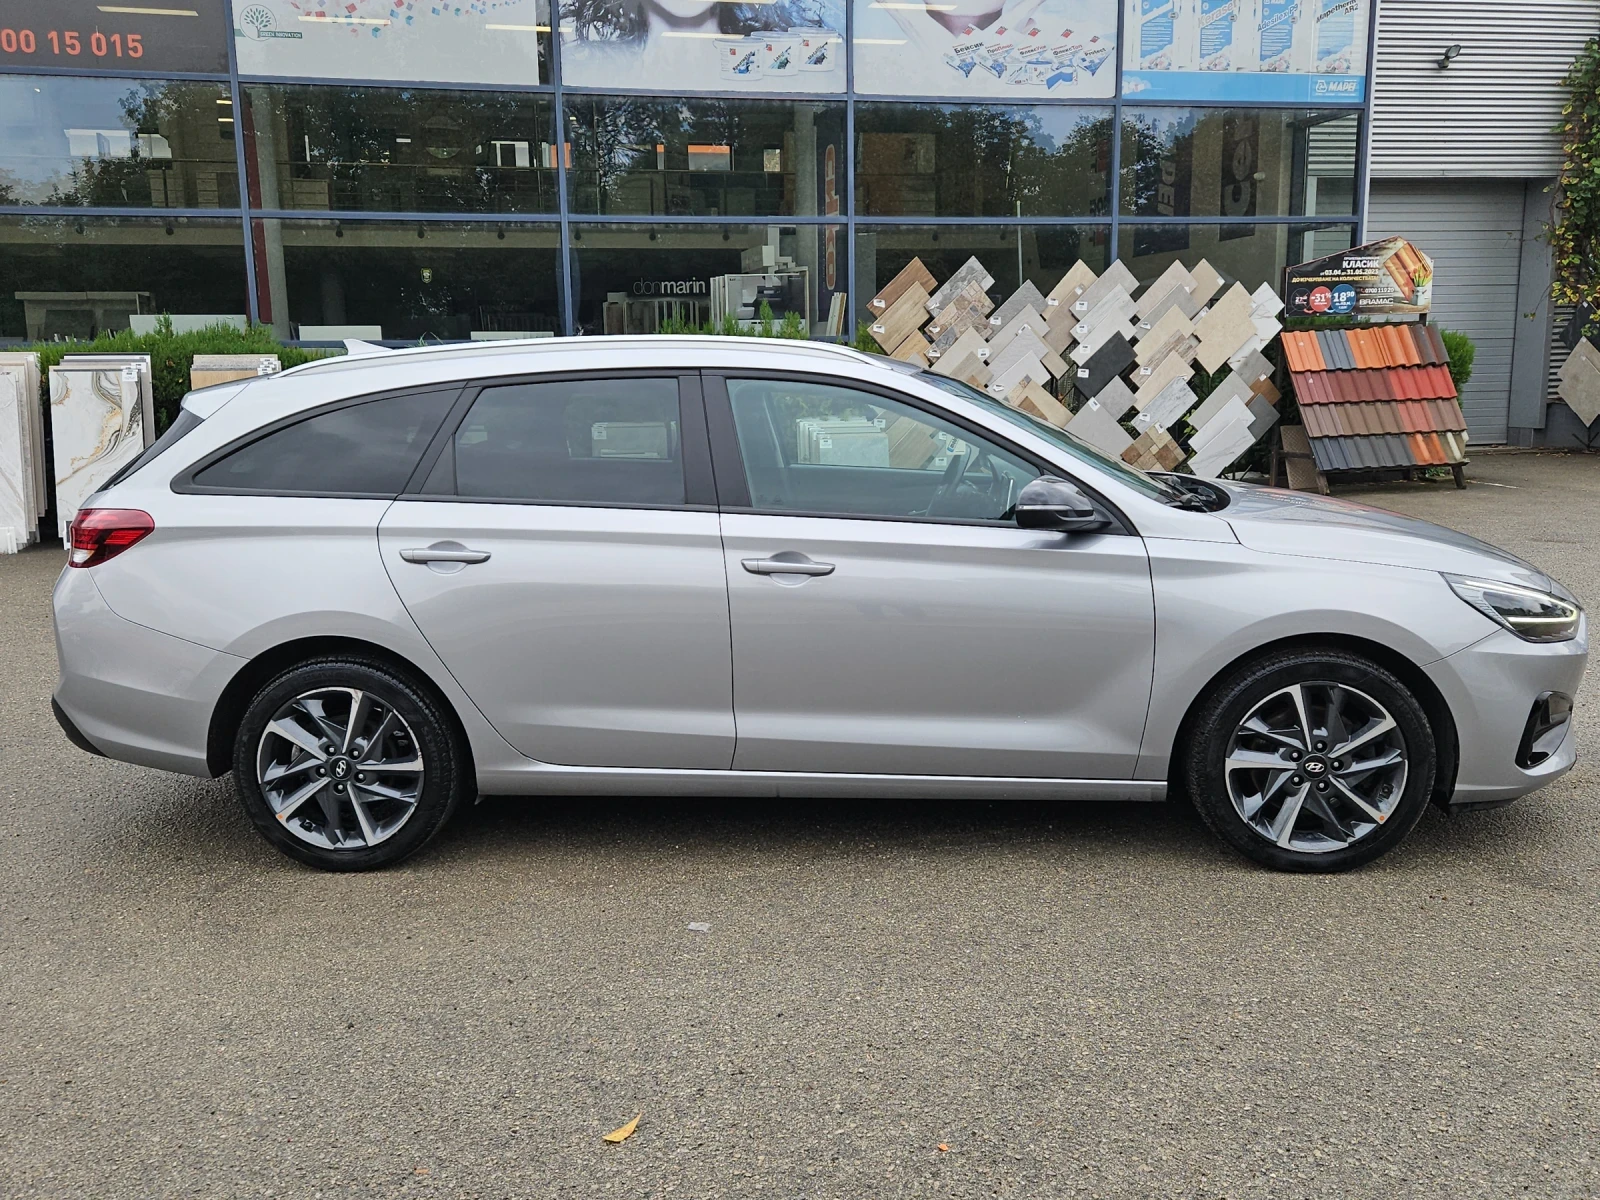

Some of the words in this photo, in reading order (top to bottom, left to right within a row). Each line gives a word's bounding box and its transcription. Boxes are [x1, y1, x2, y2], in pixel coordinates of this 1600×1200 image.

[1344, 4, 1359, 15] AR2
[1257, 12, 1289, 32] Adesilex
[1289, 3, 1299, 15] P9
[47, 30, 81, 55] 15
[90, 32, 144, 58] 015
[954, 42, 984, 54] Бейсик
[1328, 81, 1357, 92] MAPEI
[1342, 260, 1380, 269] КЛАСИК
[633, 277, 706, 295] donmarin
